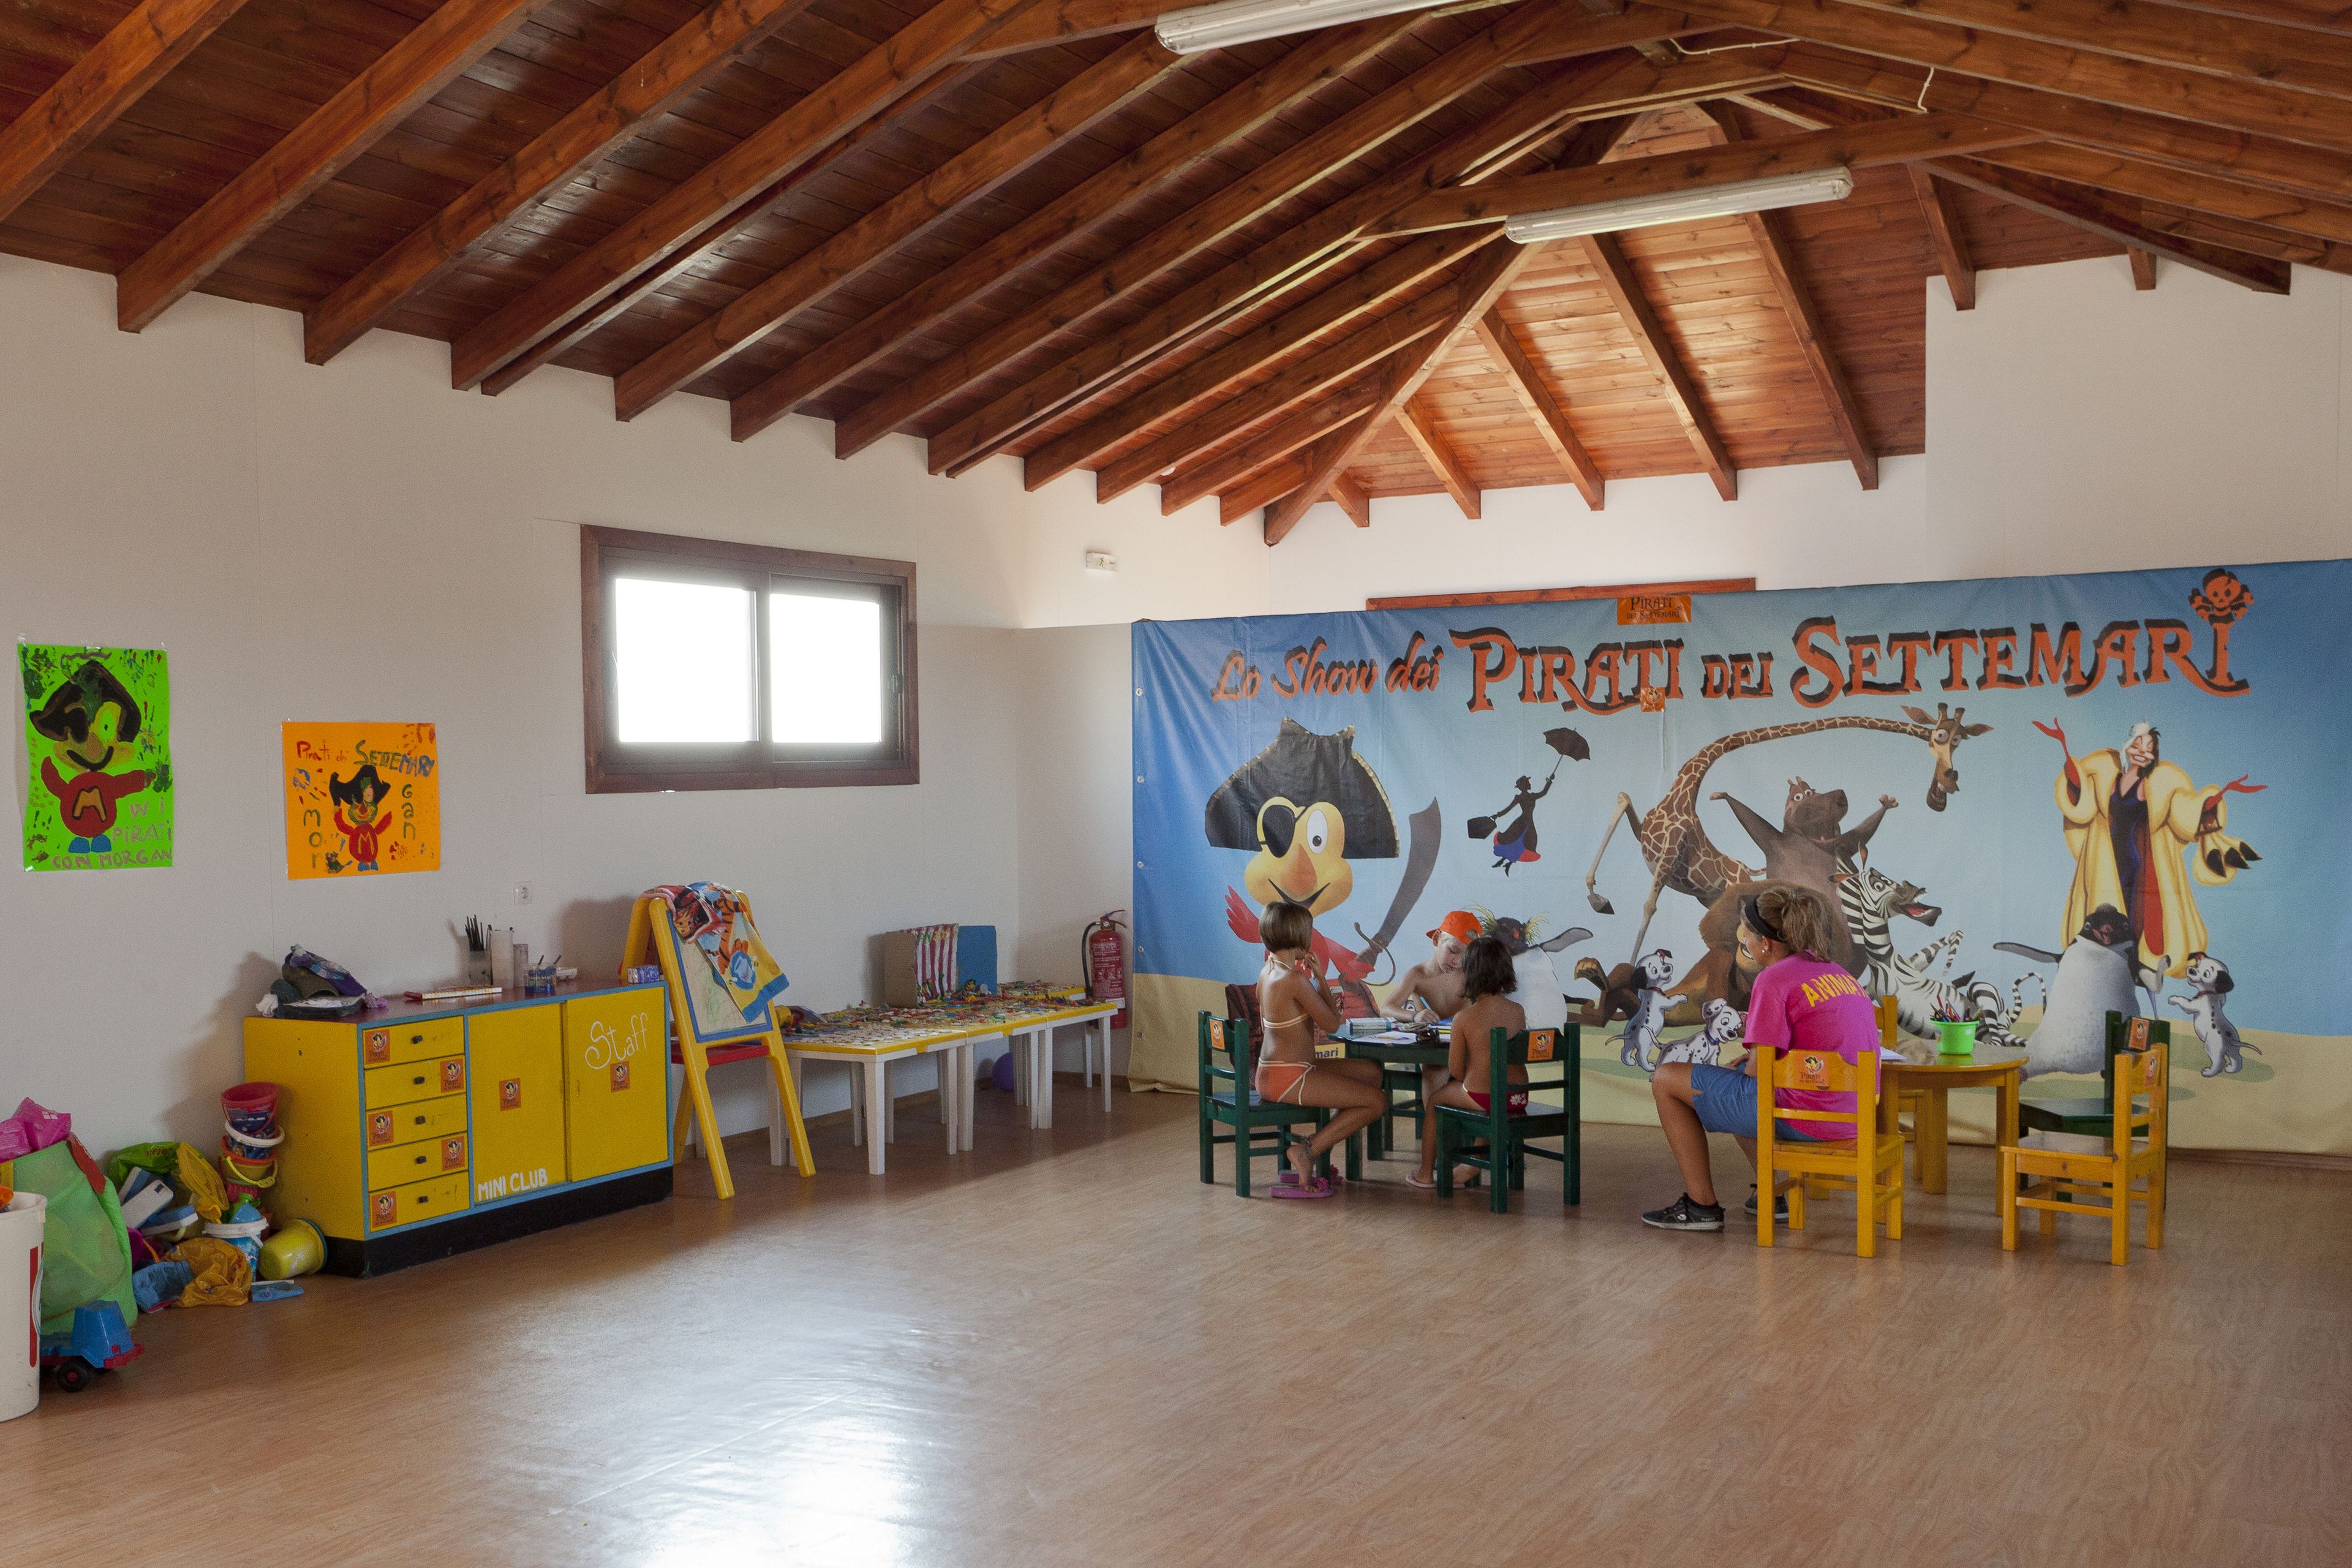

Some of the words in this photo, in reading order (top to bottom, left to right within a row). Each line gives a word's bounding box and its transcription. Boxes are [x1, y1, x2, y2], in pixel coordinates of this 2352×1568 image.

[1630, 597, 1672, 611] PIRATI
[1212, 650, 1262, 703] Lo
[1270, 636, 1379, 699] Show
[1386, 630, 1444, 693] dei
[1449, 626, 1685, 716] PIRATI
[1701, 650, 1774, 700] DEI
[1790, 615, 2251, 709] SETTEMARI
[52, 853, 92, 870] CON
[98, 847, 172, 868] MORGAN
[585, 1012, 648, 1070] Staff
[1314, 1047, 1339, 1058] mari
[478, 1175, 507, 1201] MINI
[510, 1167, 548, 1192] CLUB
